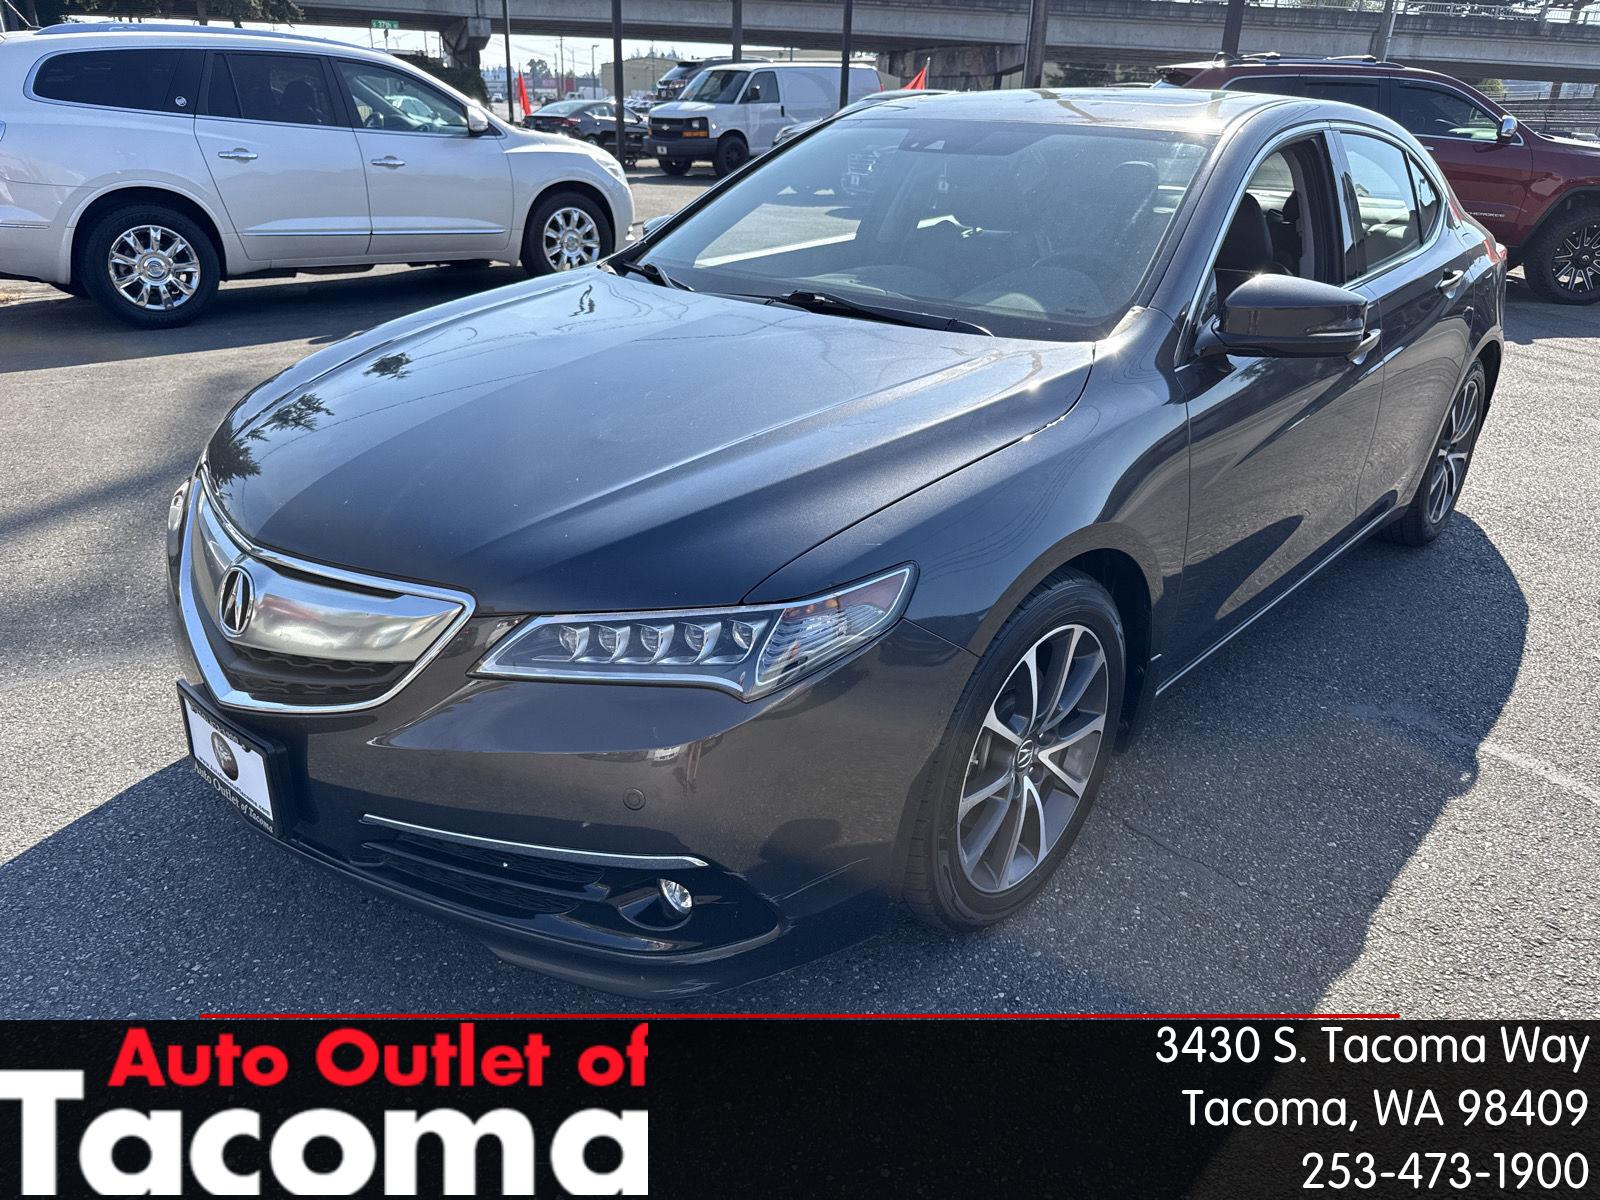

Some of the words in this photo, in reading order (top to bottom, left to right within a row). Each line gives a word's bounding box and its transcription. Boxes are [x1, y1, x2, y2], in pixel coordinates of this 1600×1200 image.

[193, 761, 212, 785] Auto
[213, 778, 240, 808] Outlet
[248, 807, 274, 834] Tacoma
